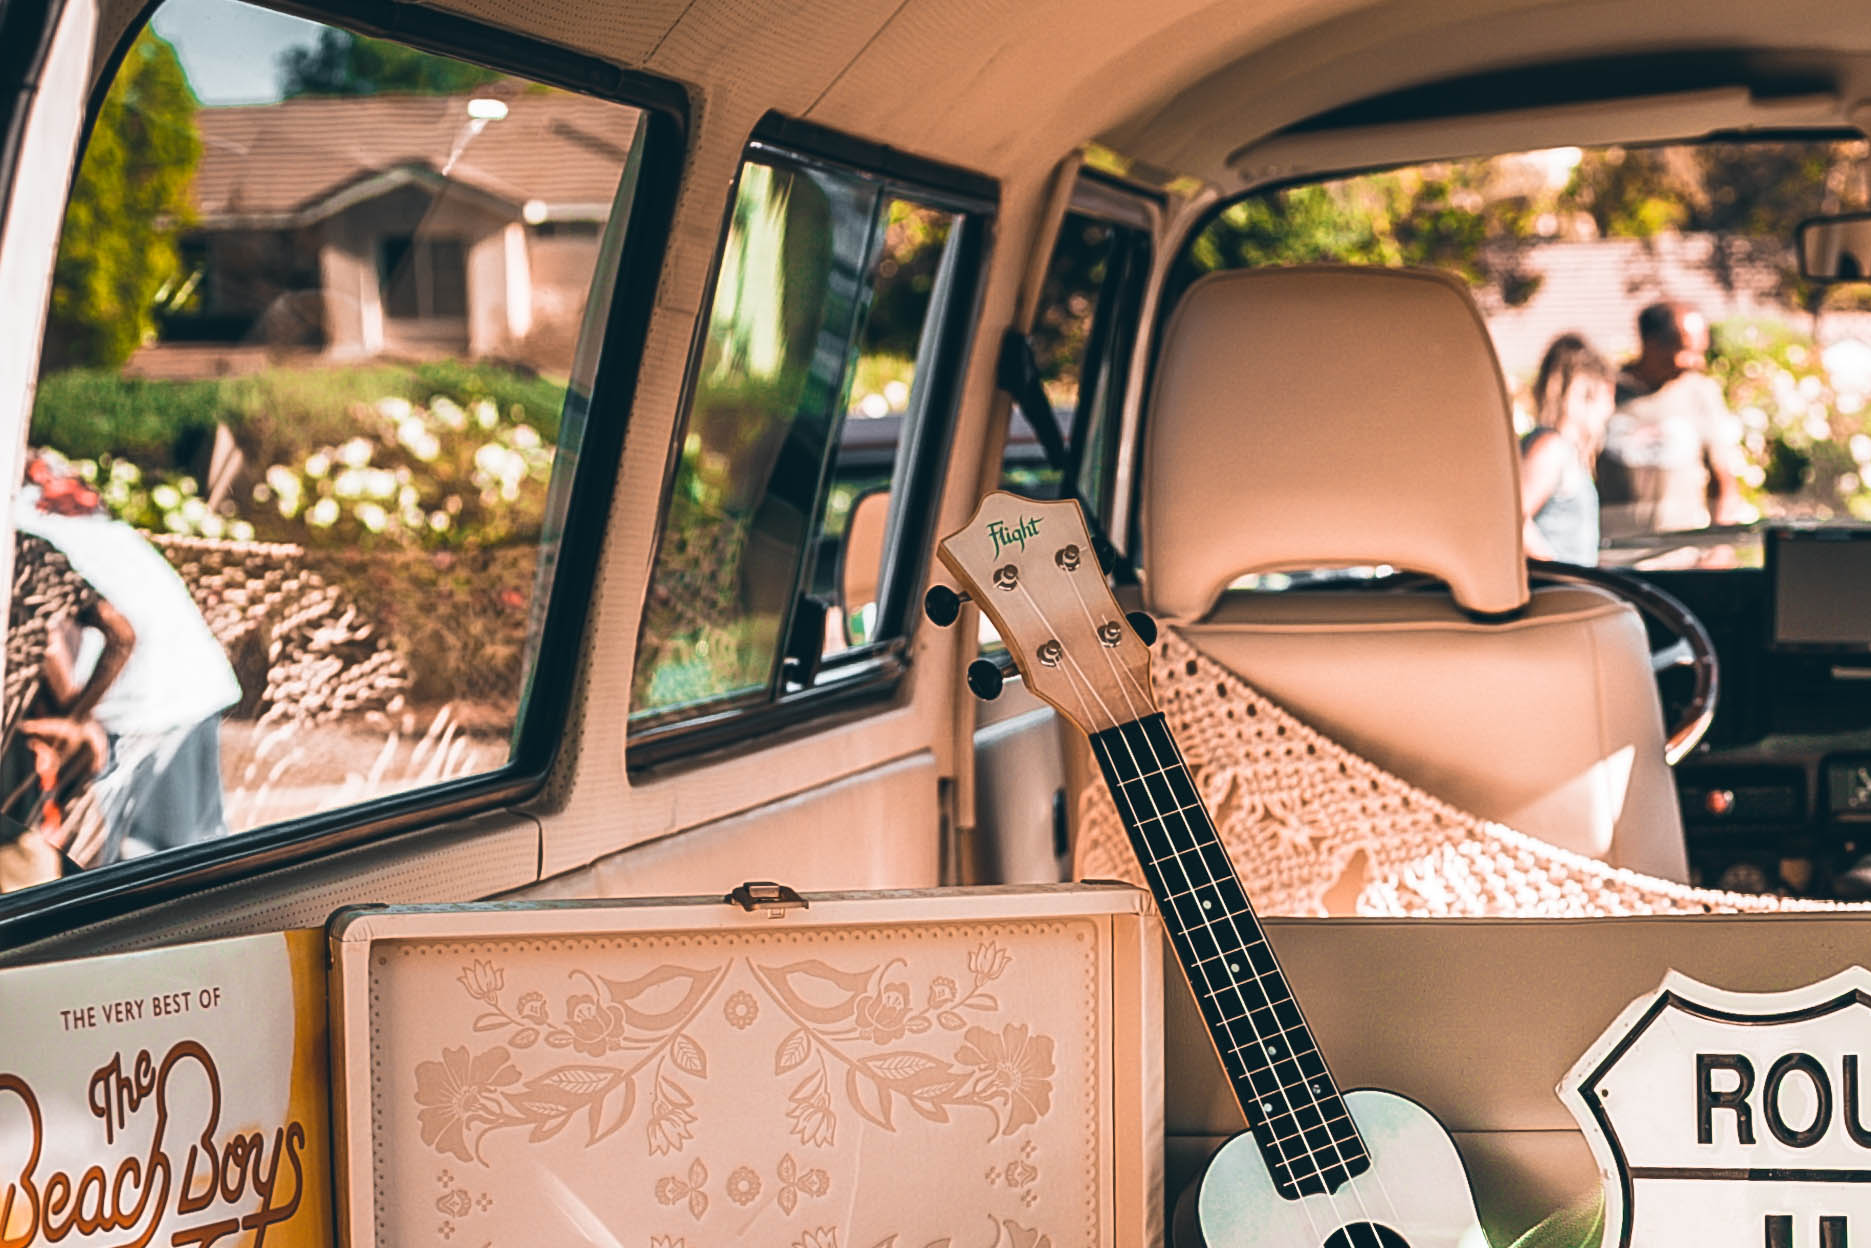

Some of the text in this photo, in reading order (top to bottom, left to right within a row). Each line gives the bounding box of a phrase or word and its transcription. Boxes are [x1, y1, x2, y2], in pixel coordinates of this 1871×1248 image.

[985, 514, 1045, 563] Flight
[60, 987, 221, 1031] THE VERY BEST OF
[89, 1049, 158, 1145] The
